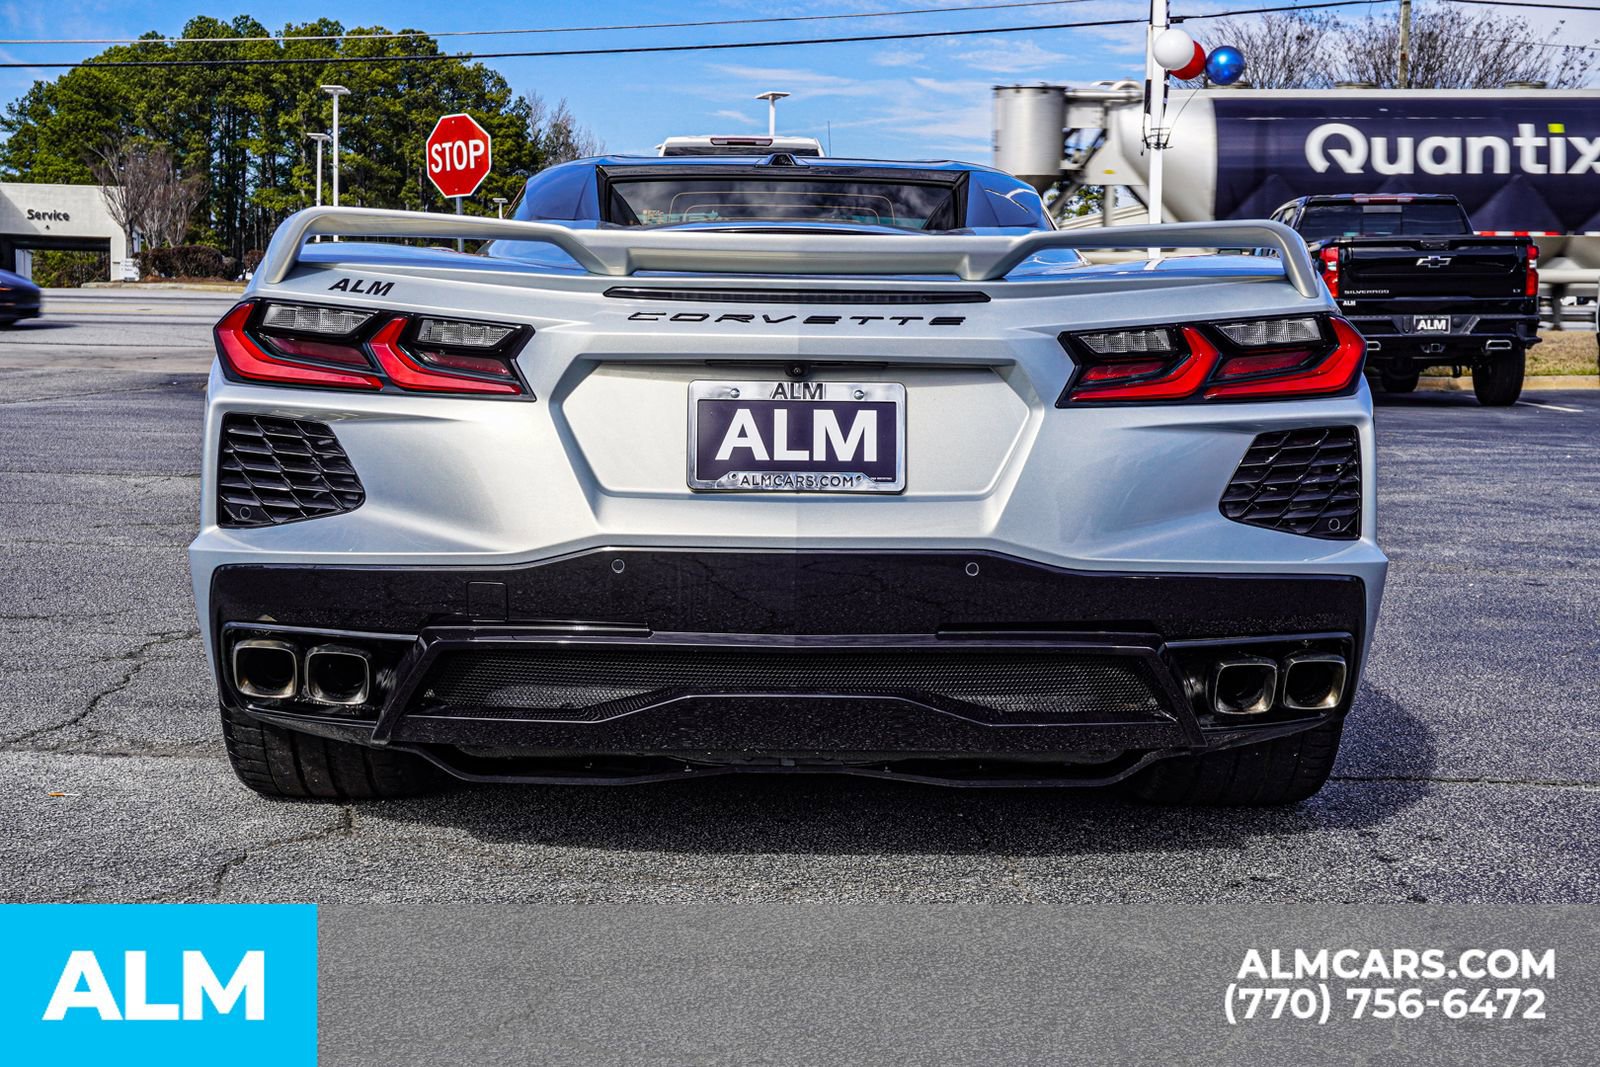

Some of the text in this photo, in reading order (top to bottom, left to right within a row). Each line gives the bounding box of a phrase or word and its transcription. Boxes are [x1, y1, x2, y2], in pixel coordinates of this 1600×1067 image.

[431, 139, 485, 174] STOP
[27, 208, 70, 221] Service
[328, 278, 395, 297] ALM
[628, 312, 966, 326] CORVETTE
[1417, 319, 1446, 330] ALM
[771, 382, 825, 400] ALM
[715, 408, 878, 462] ALM
[740, 474, 854, 487] ALMCARS.COM
